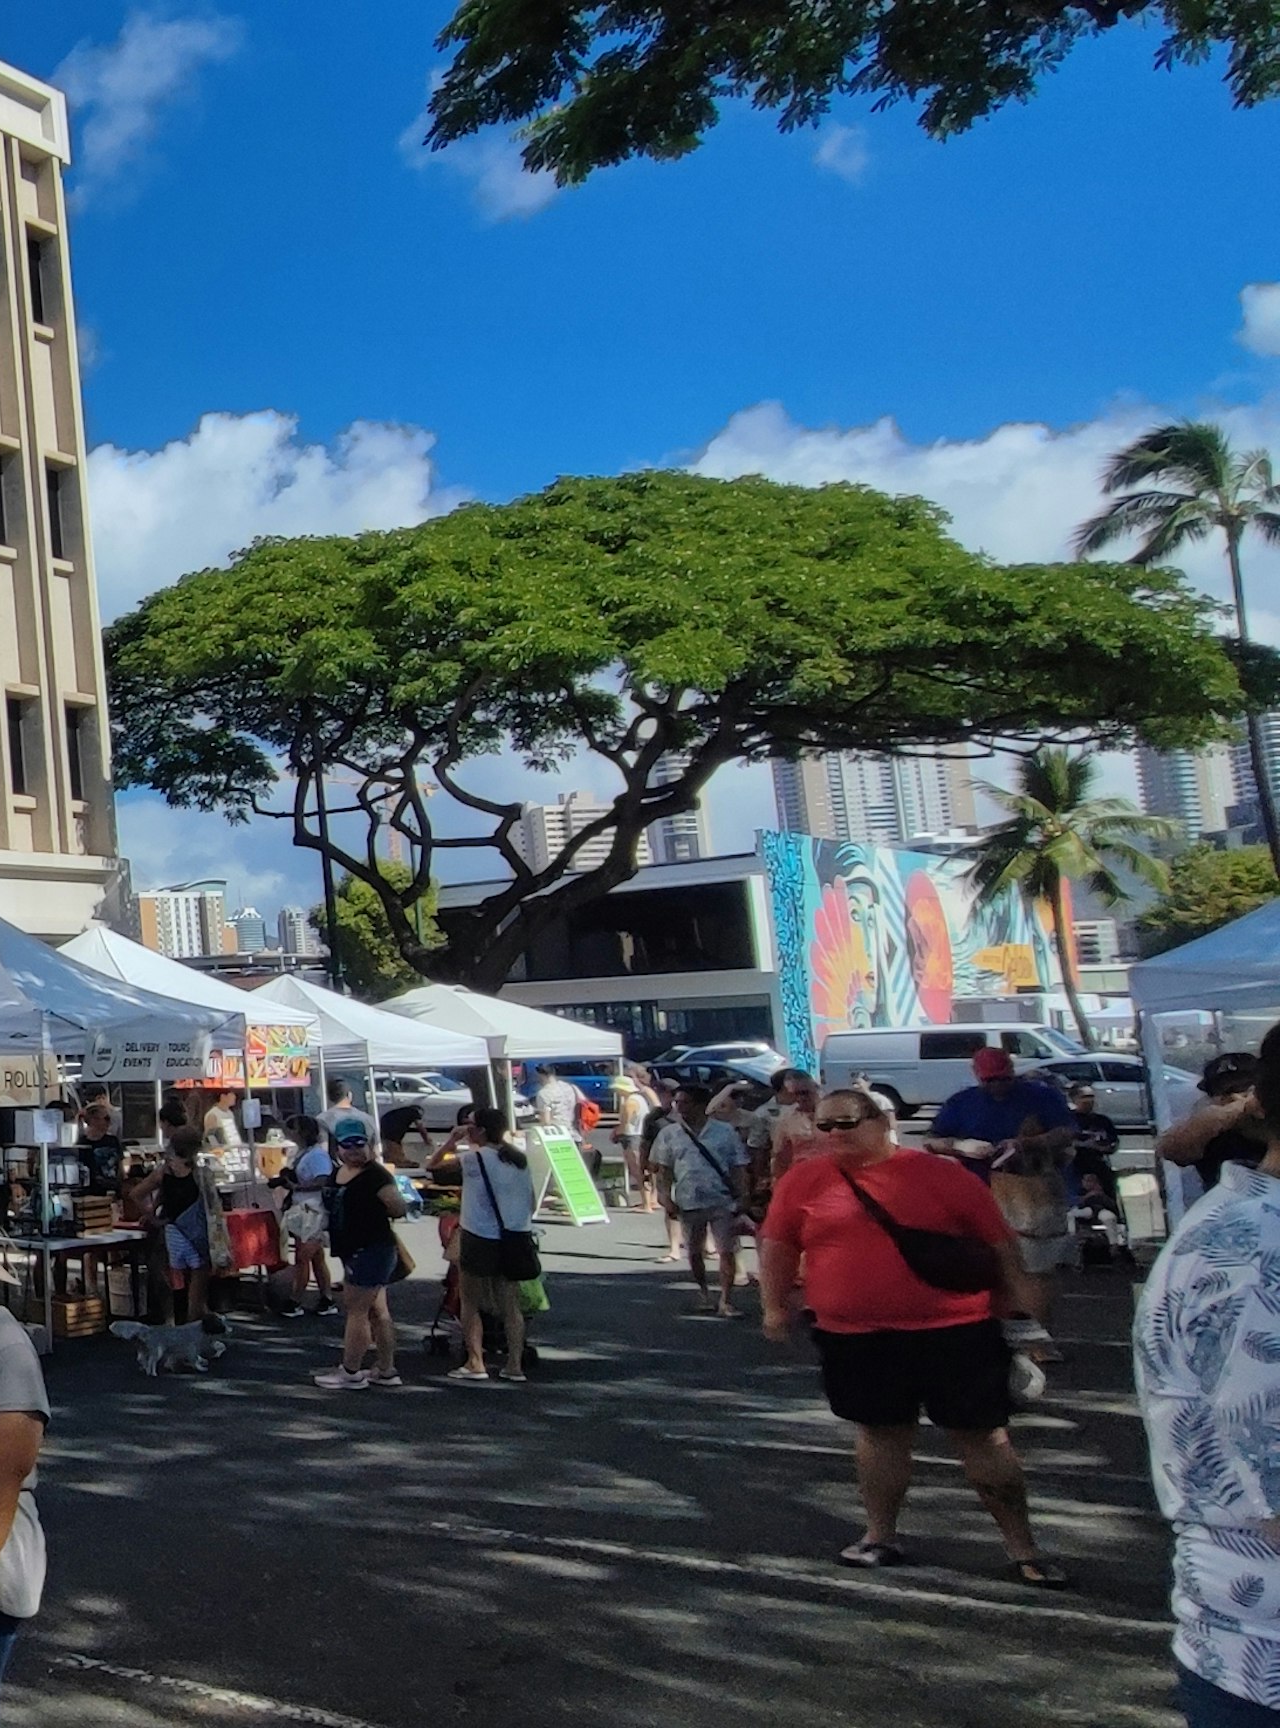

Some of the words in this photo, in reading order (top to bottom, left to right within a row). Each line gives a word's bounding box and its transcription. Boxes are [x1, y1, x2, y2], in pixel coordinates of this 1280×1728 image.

[125, 1042, 160, 1052] DELIVERY
[168, 1042, 191, 1052] TOURS
[122, 1057, 152, 1068] EVENTS
